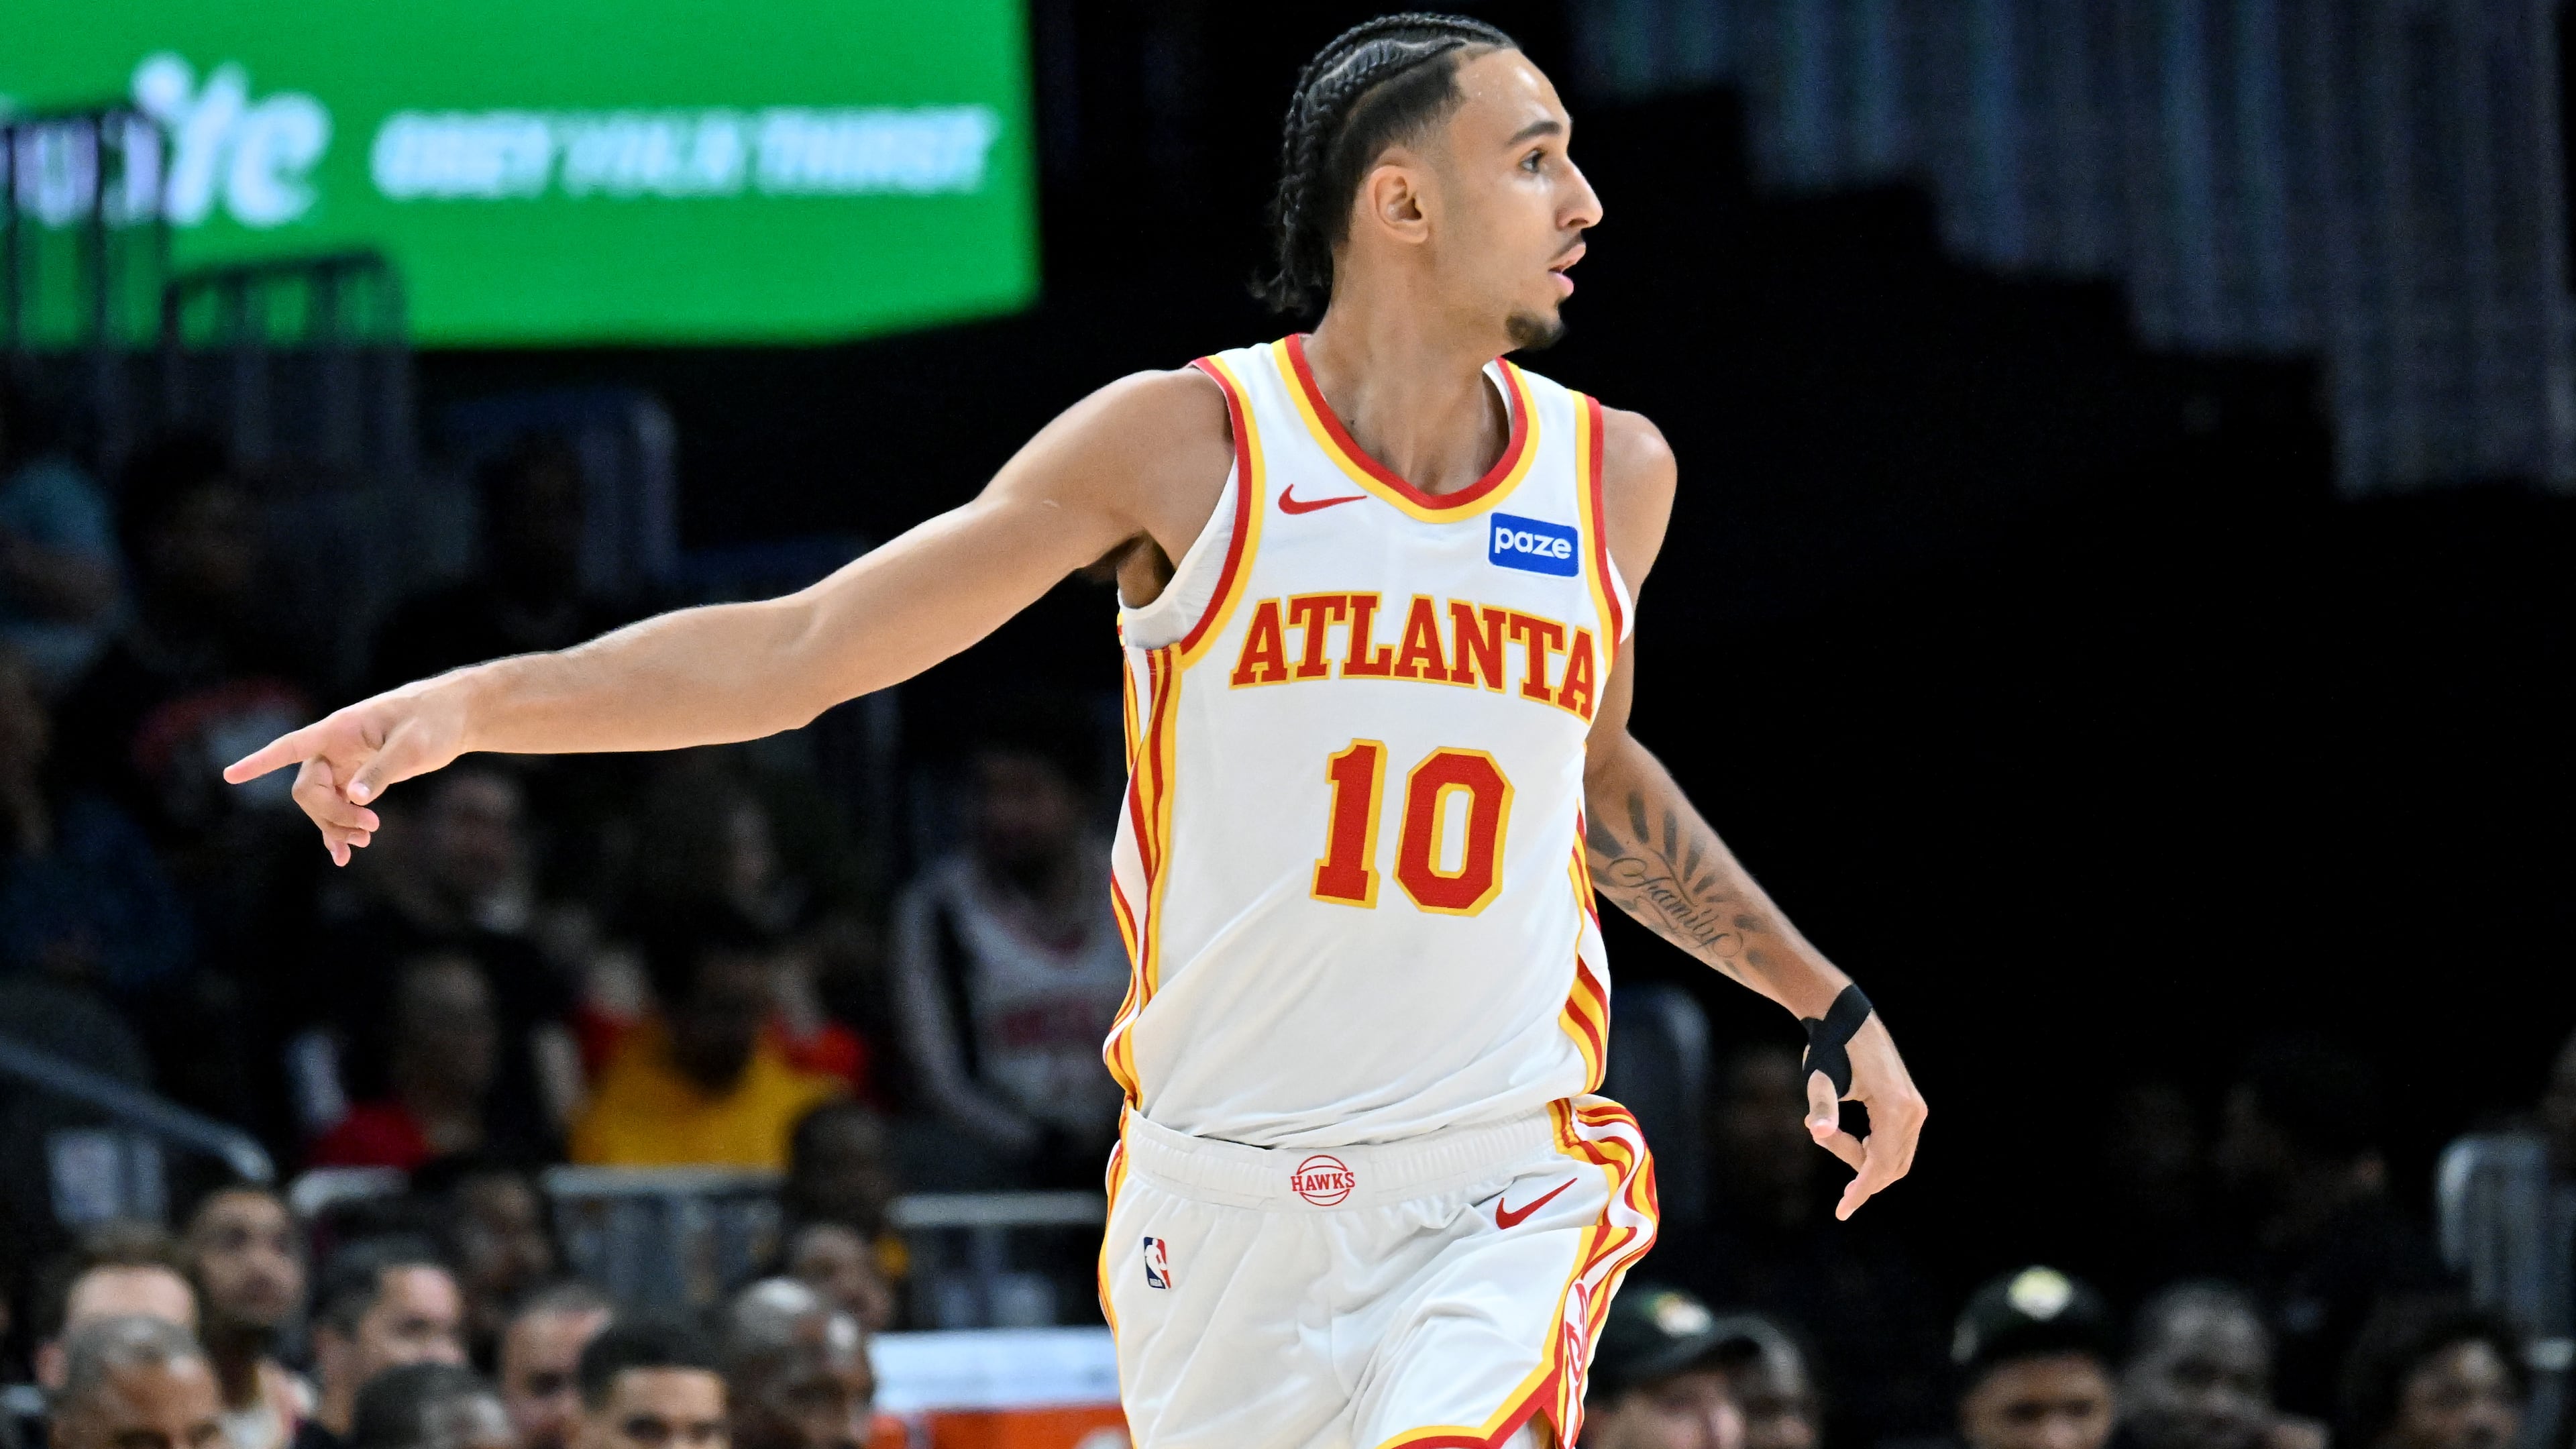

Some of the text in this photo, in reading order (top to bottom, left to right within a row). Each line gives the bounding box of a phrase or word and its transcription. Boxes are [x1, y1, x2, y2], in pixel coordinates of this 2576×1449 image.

[1495, 526, 1572, 561] paze
[1229, 592, 1595, 723] ATLANTA
[1309, 738, 1515, 917] 10
[1290, 1172, 1356, 1191] HAWKS
